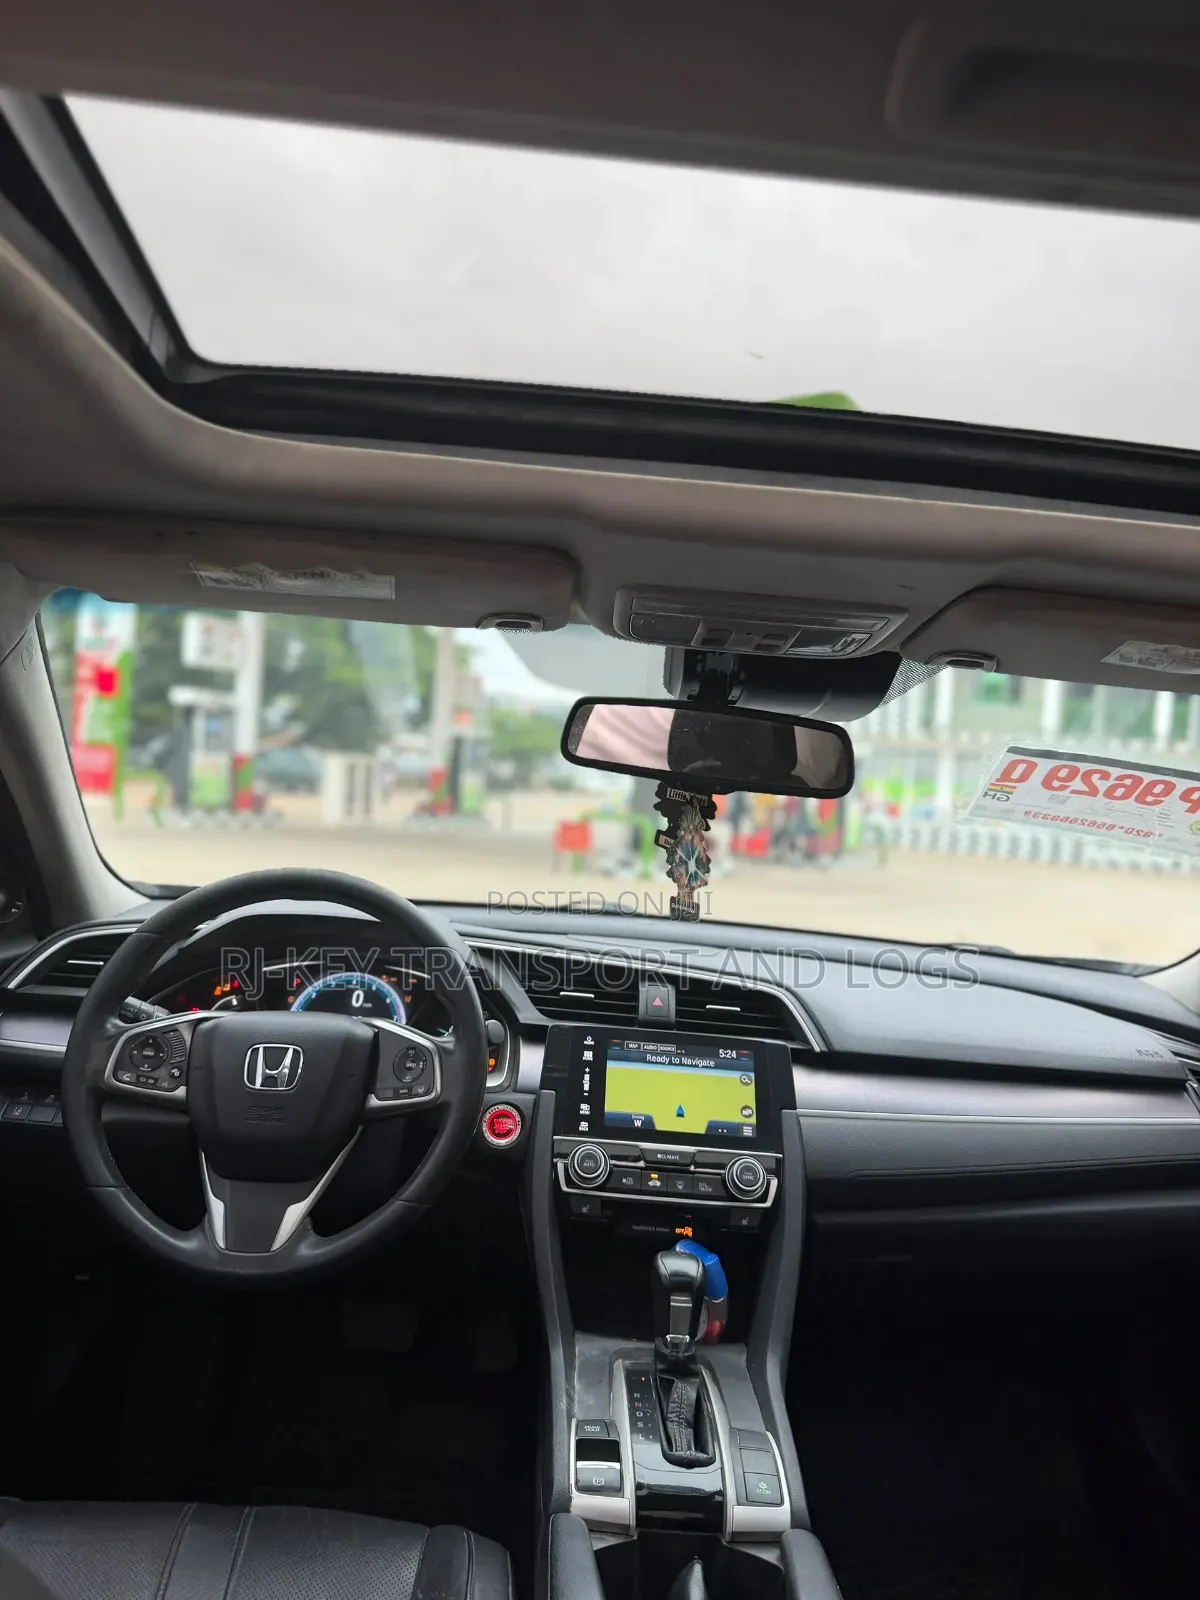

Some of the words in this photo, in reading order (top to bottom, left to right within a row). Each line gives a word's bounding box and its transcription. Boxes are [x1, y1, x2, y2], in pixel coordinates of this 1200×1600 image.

[351, 990, 364, 1008] 0
[719, 1049, 737, 1059] 5:24
[646, 1054, 670, 1065] Ready
[672, 1055, 680, 1064] to
[681, 1057, 715, 1068] Navigate
[633, 1119, 643, 1128] W
